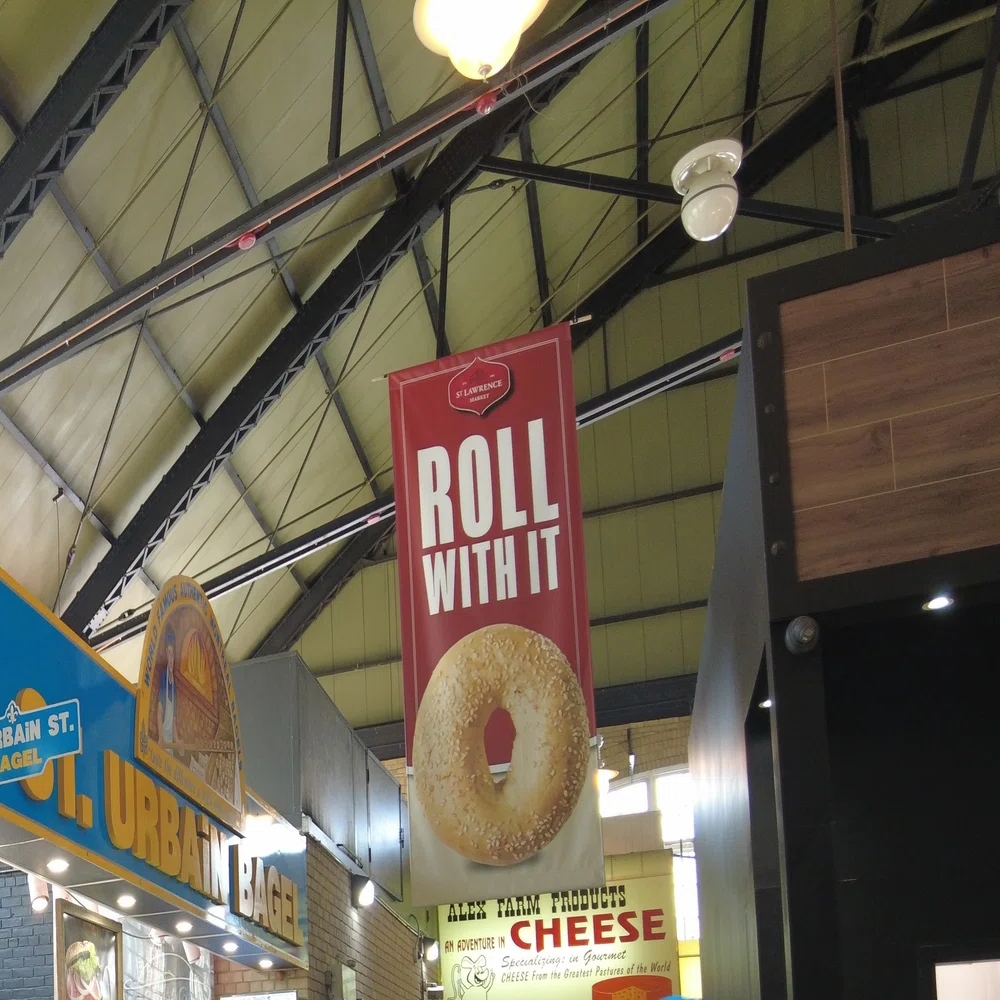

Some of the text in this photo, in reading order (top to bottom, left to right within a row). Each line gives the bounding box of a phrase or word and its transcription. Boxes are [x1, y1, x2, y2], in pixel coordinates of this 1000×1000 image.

[463, 380, 503, 397] LAWRENCE
[417, 417, 560, 550] ROLL
[422, 525, 560, 616] WITH IT
[47, 711, 75, 737] ST.
[231, 843, 304, 947] BAGEL
[447, 884, 626, 922] ALEX FARM PRODUCTS
[444, 908, 666, 953] AN ADVENTURE IN CHEESE
[501, 960, 672, 983] CHEESE From the Greatest Pastures of the World
[568, 953, 579, 963] in
[583, 949, 627, 966] Gourmet
